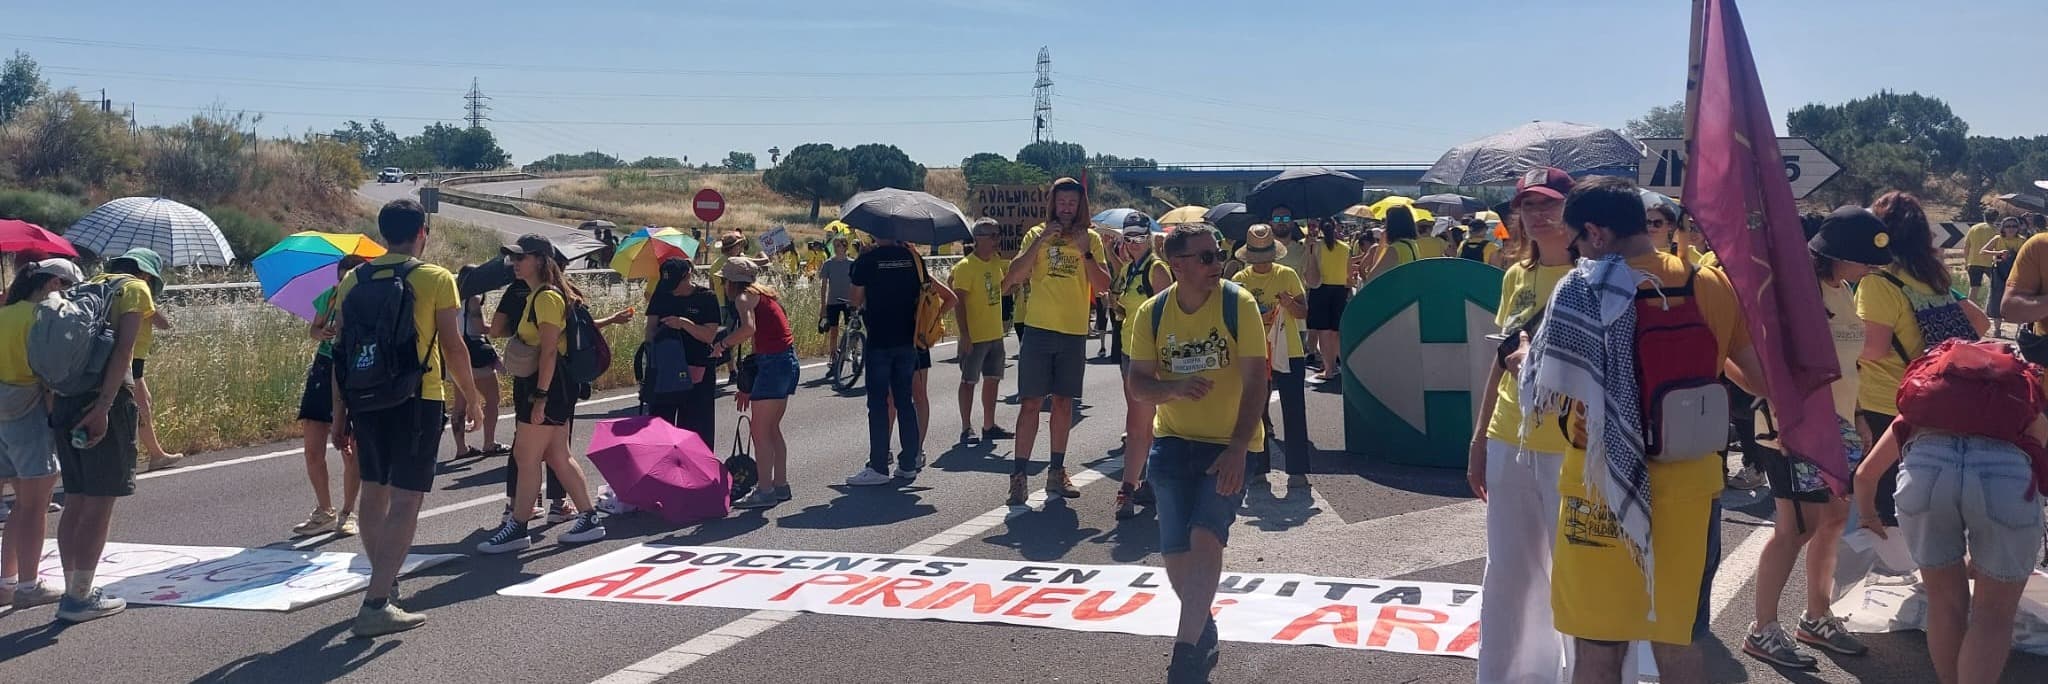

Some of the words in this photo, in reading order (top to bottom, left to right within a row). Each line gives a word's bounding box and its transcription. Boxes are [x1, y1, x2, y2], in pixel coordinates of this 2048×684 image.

[1782, 155, 1801, 182] 5
[542, 566, 785, 601] ALT
[768, 573, 1156, 621] PIRINEU
[636, 550, 968, 577] DOCENTS
[1002, 566, 1101, 584] EN
[1127, 572, 1479, 607] LUITA!
